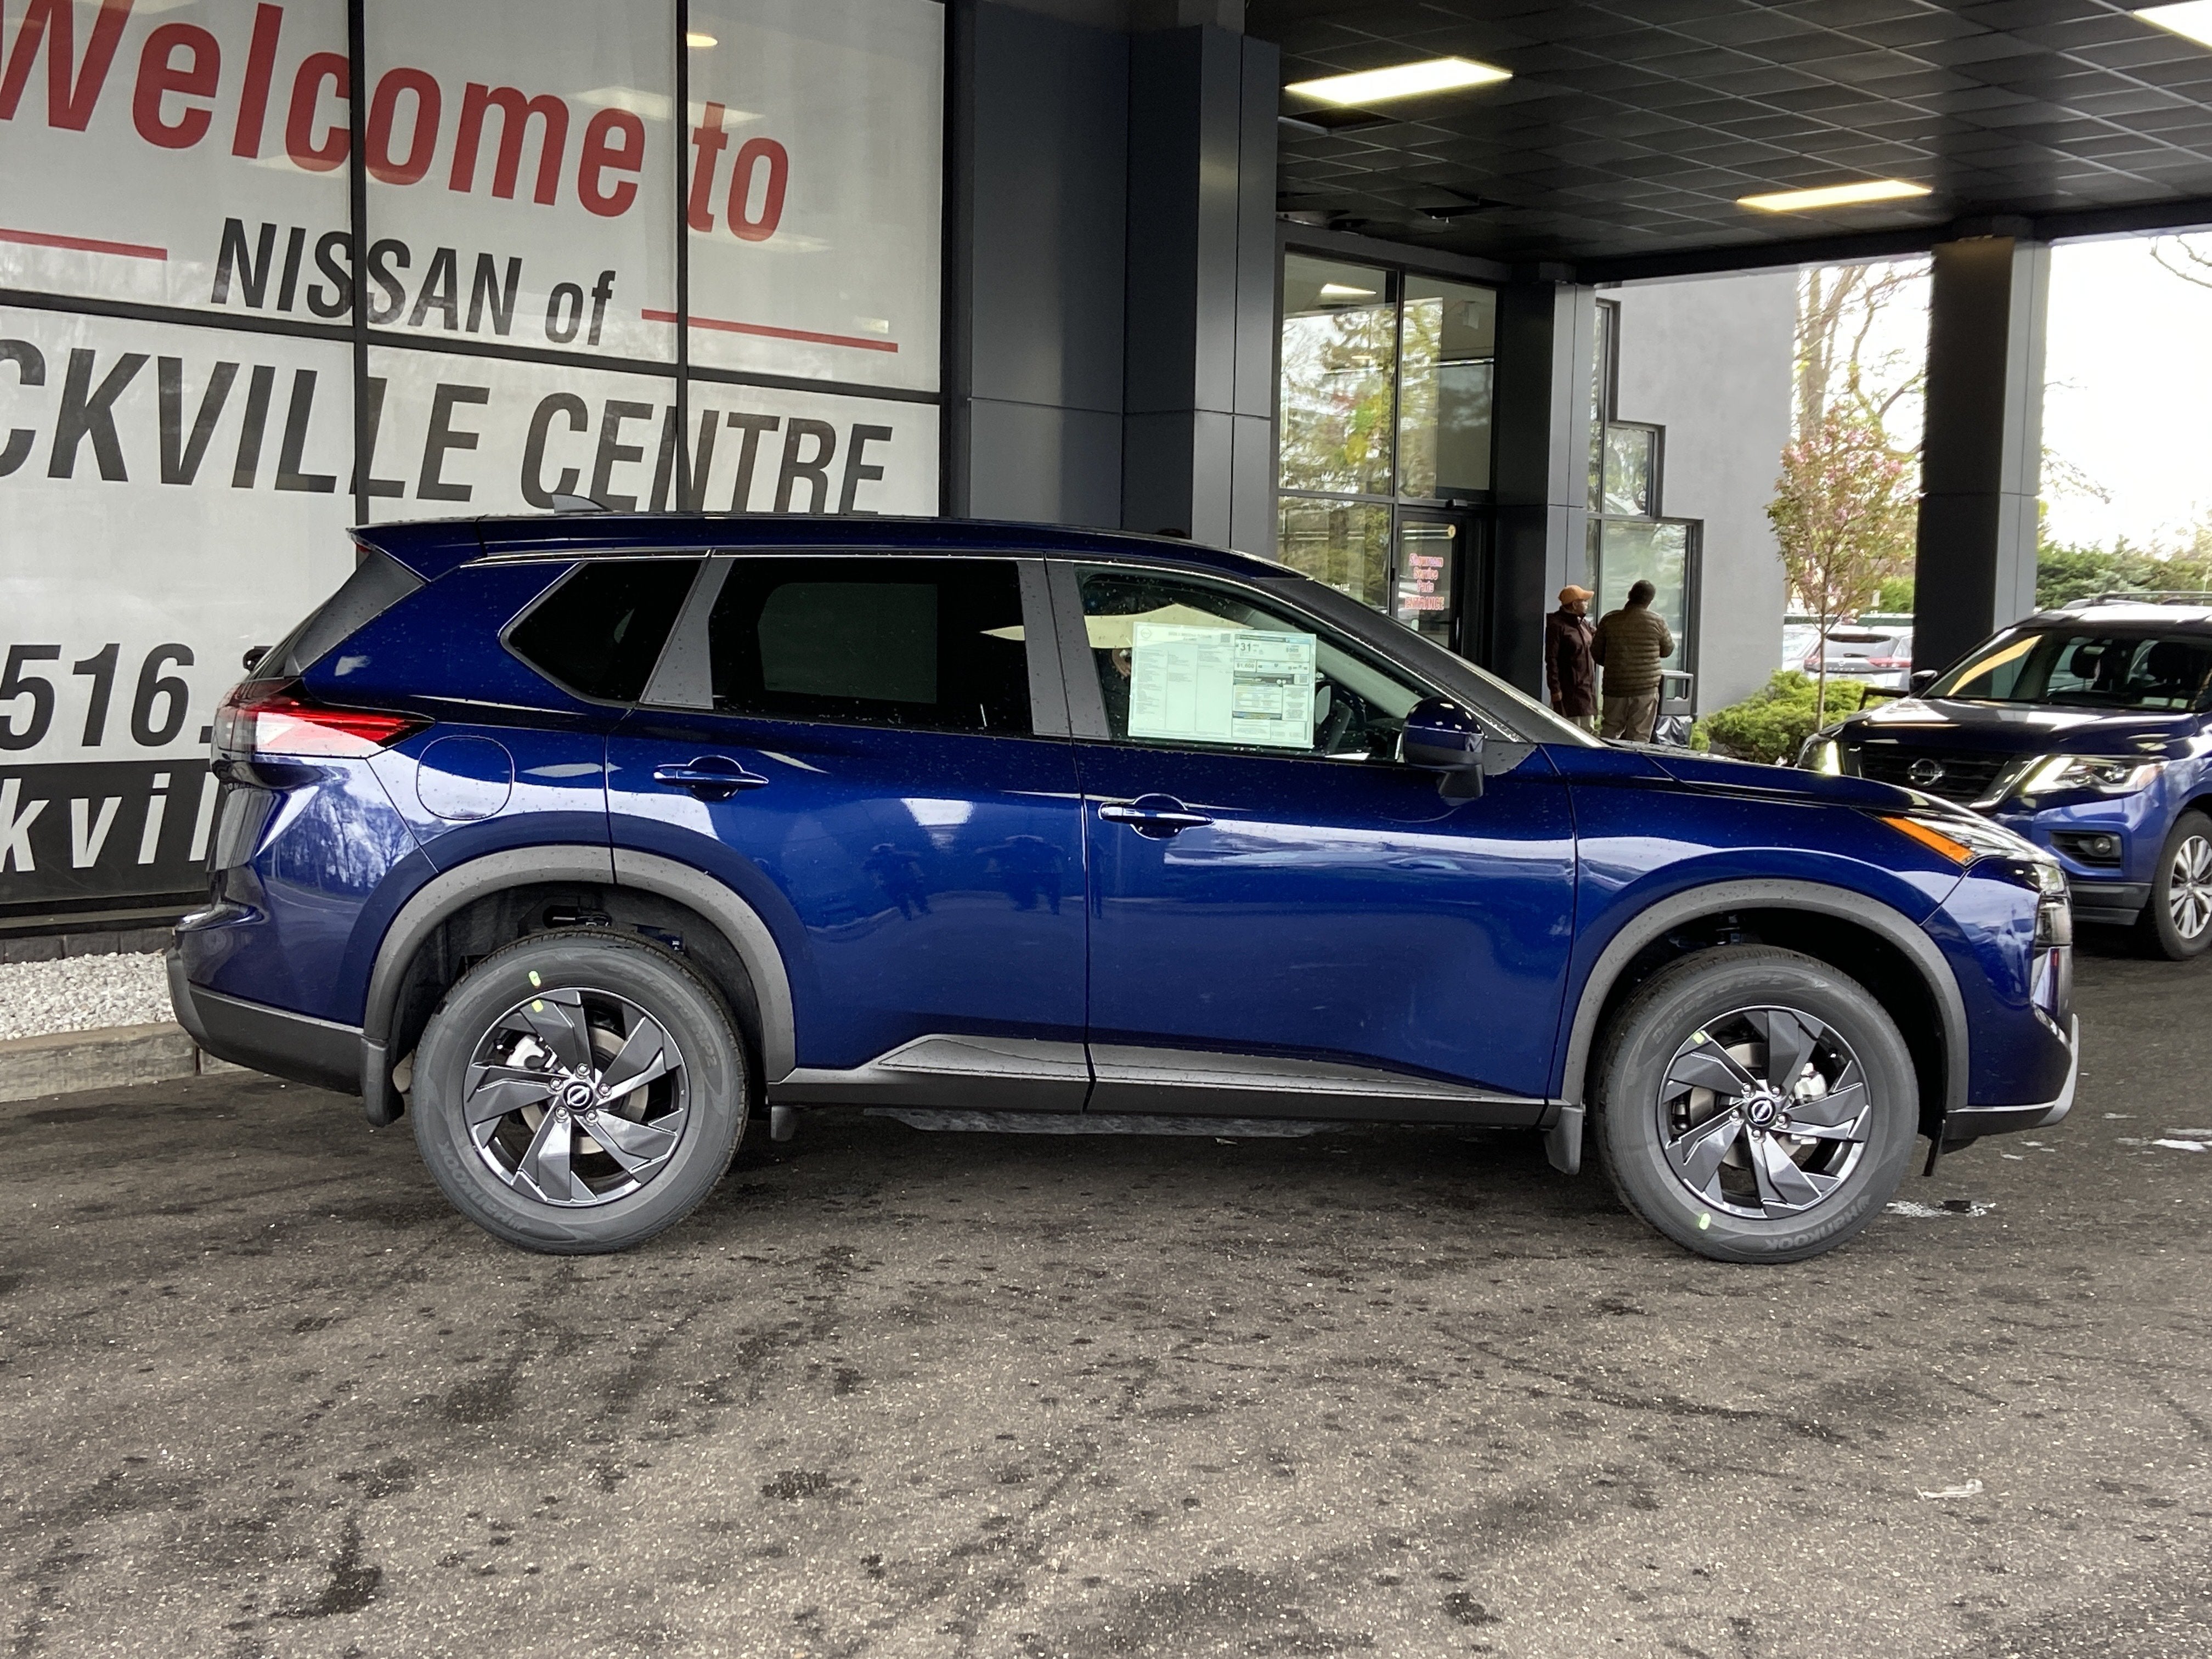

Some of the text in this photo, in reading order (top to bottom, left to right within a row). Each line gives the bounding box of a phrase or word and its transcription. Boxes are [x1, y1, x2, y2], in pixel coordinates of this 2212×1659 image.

[688, 101, 789, 242] to
[211, 217, 616, 346] NISSAN of
[521, 392, 893, 513] CENTRE
[1240, 642, 1251, 652] 31
